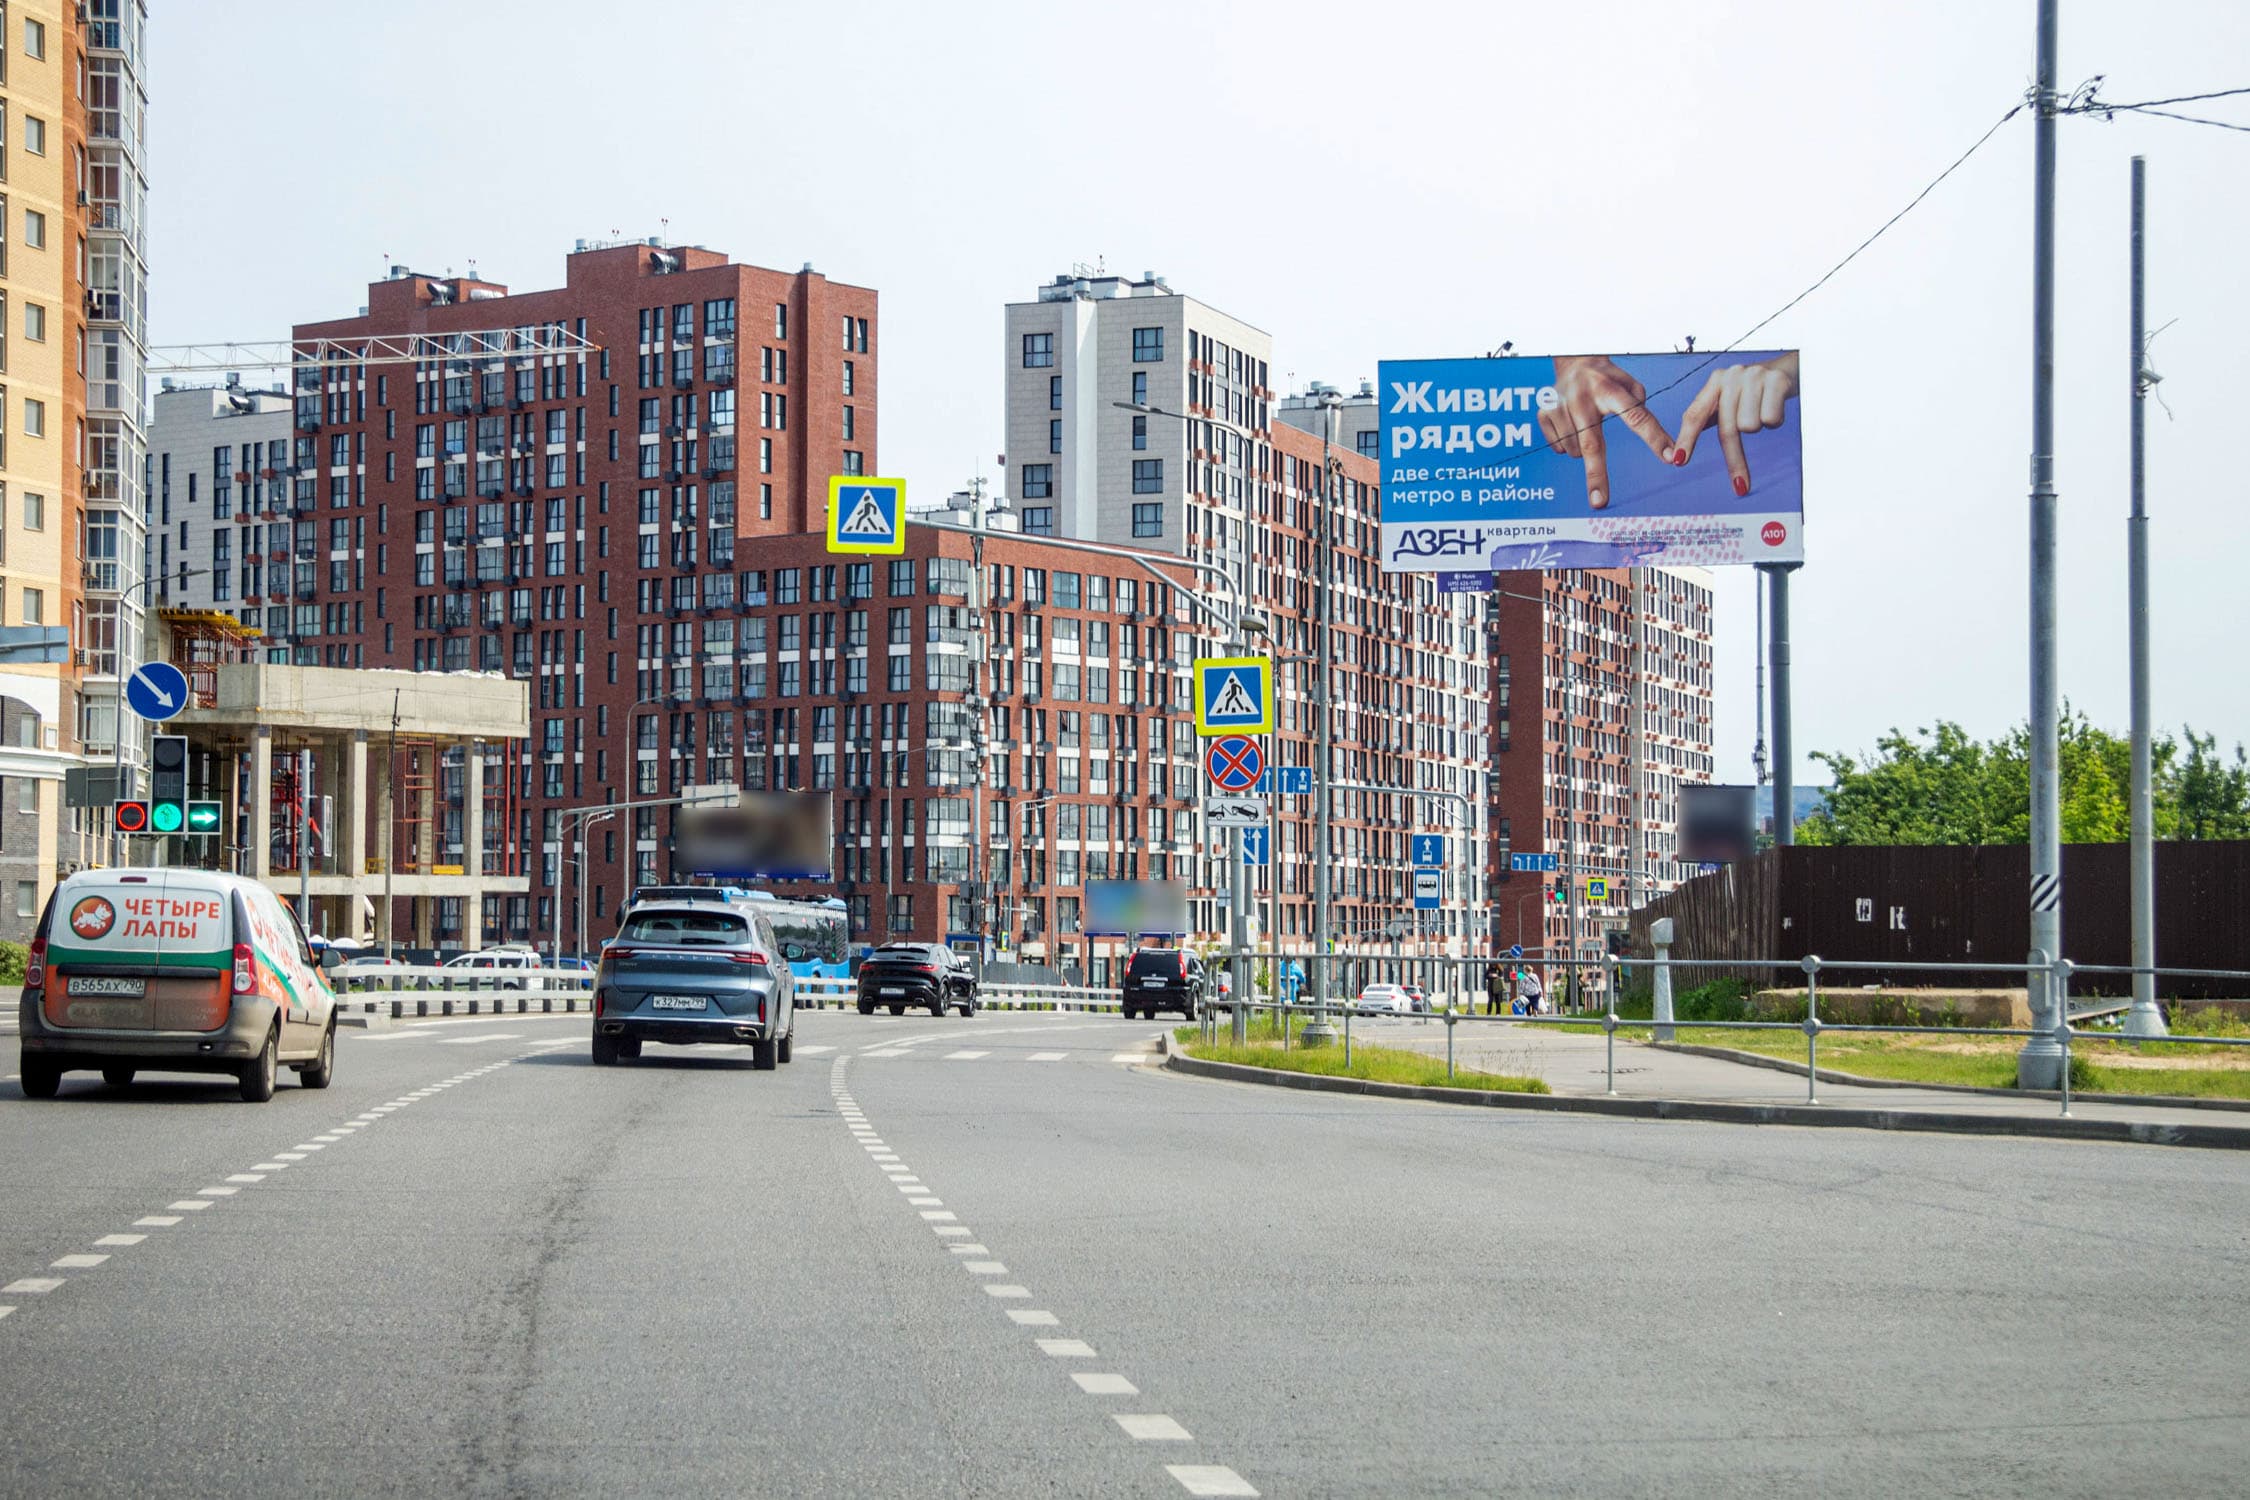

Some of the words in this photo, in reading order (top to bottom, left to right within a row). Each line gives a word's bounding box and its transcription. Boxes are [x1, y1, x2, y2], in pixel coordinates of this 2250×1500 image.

[1390, 381, 1559, 414] Живите
[1391, 423, 1532, 458] рядом
[1392, 467, 1429, 483] две
[1435, 465, 1520, 482] станции
[1393, 489, 1455, 506] метро
[1461, 489, 1472, 502] в
[1479, 484, 1554, 505] районе
[1487, 525, 1556, 538] кварталы
[1393, 528, 1486, 562] ДЗЕН
[125, 898, 220, 919] ЧЕТЫРЕ
[122, 919, 197, 939] ЛАПЫ
